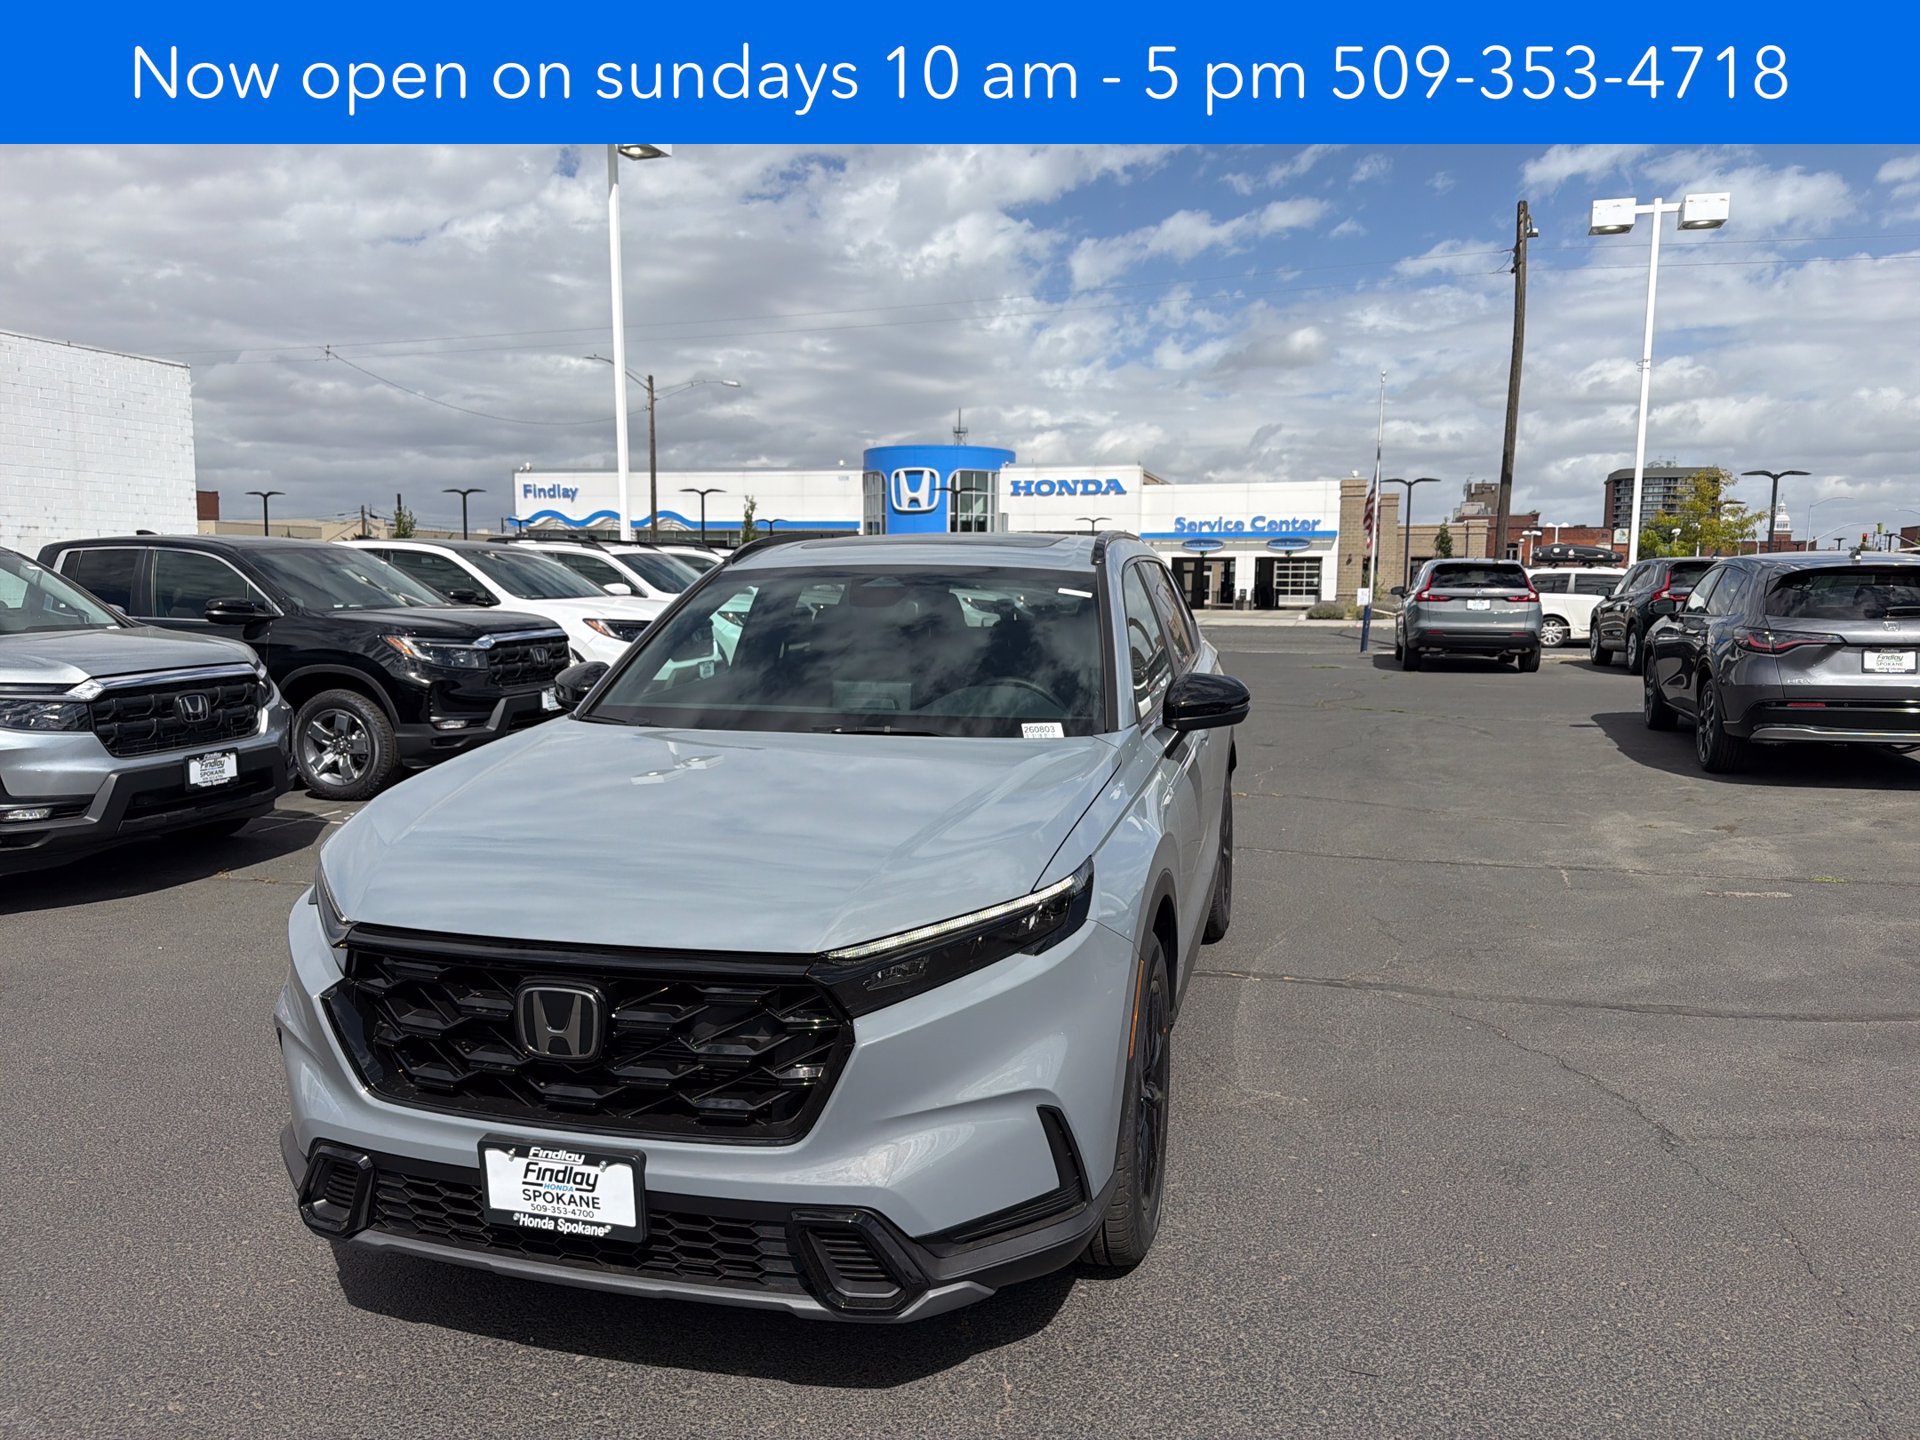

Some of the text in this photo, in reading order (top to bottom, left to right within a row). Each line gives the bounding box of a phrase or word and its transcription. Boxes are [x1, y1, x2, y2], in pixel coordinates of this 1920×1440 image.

[523, 484, 578, 502] Findlay
[1010, 479, 1127, 496] HONDA
[1175, 515, 1321, 532] Service Center
[1024, 726, 1056, 734] 260803
[200, 759, 226, 770] Findlay
[200, 768, 226, 778] SPOKANE
[528, 1147, 586, 1165] Findlay
[522, 1162, 599, 1193] Findlay
[543, 1183, 576, 1192] HONDA
[522, 1189, 601, 1210] SPOKANE
[530, 1203, 595, 1218] 509-353-4700
[519, 1213, 605, 1237] Honda Spokane
